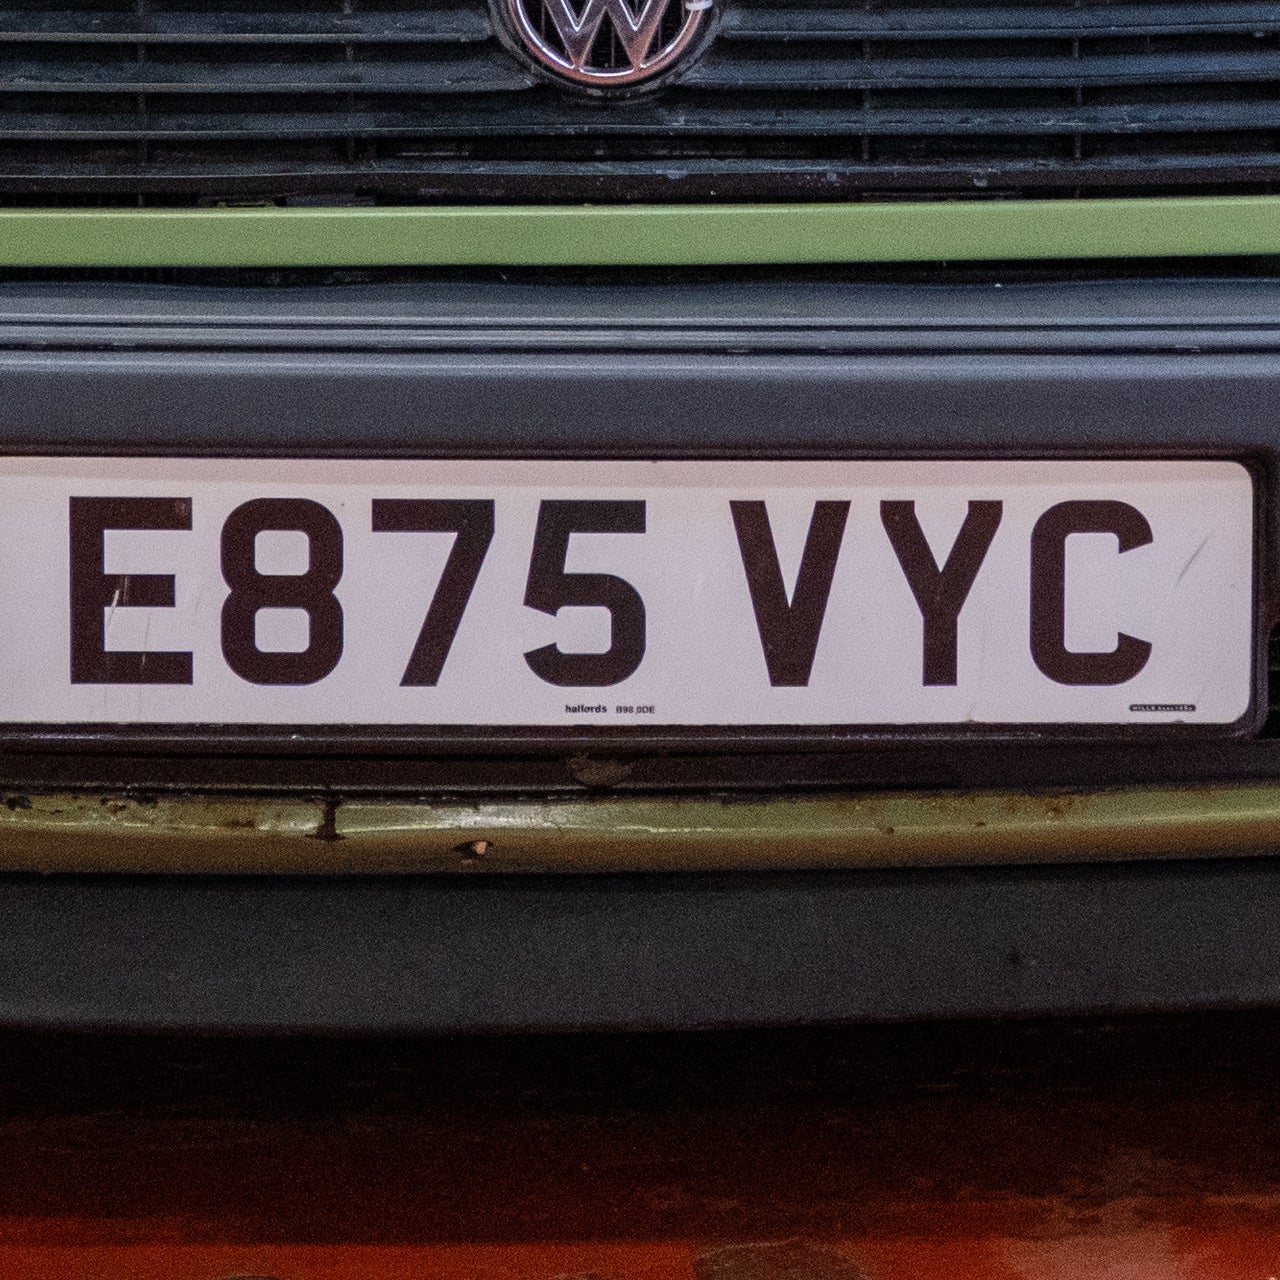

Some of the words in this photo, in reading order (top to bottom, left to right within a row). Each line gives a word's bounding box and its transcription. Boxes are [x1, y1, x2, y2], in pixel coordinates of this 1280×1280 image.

[69, 495, 646, 687] E875
[729, 499, 1155, 687] VYC
[564, 703, 608, 714] halfords
